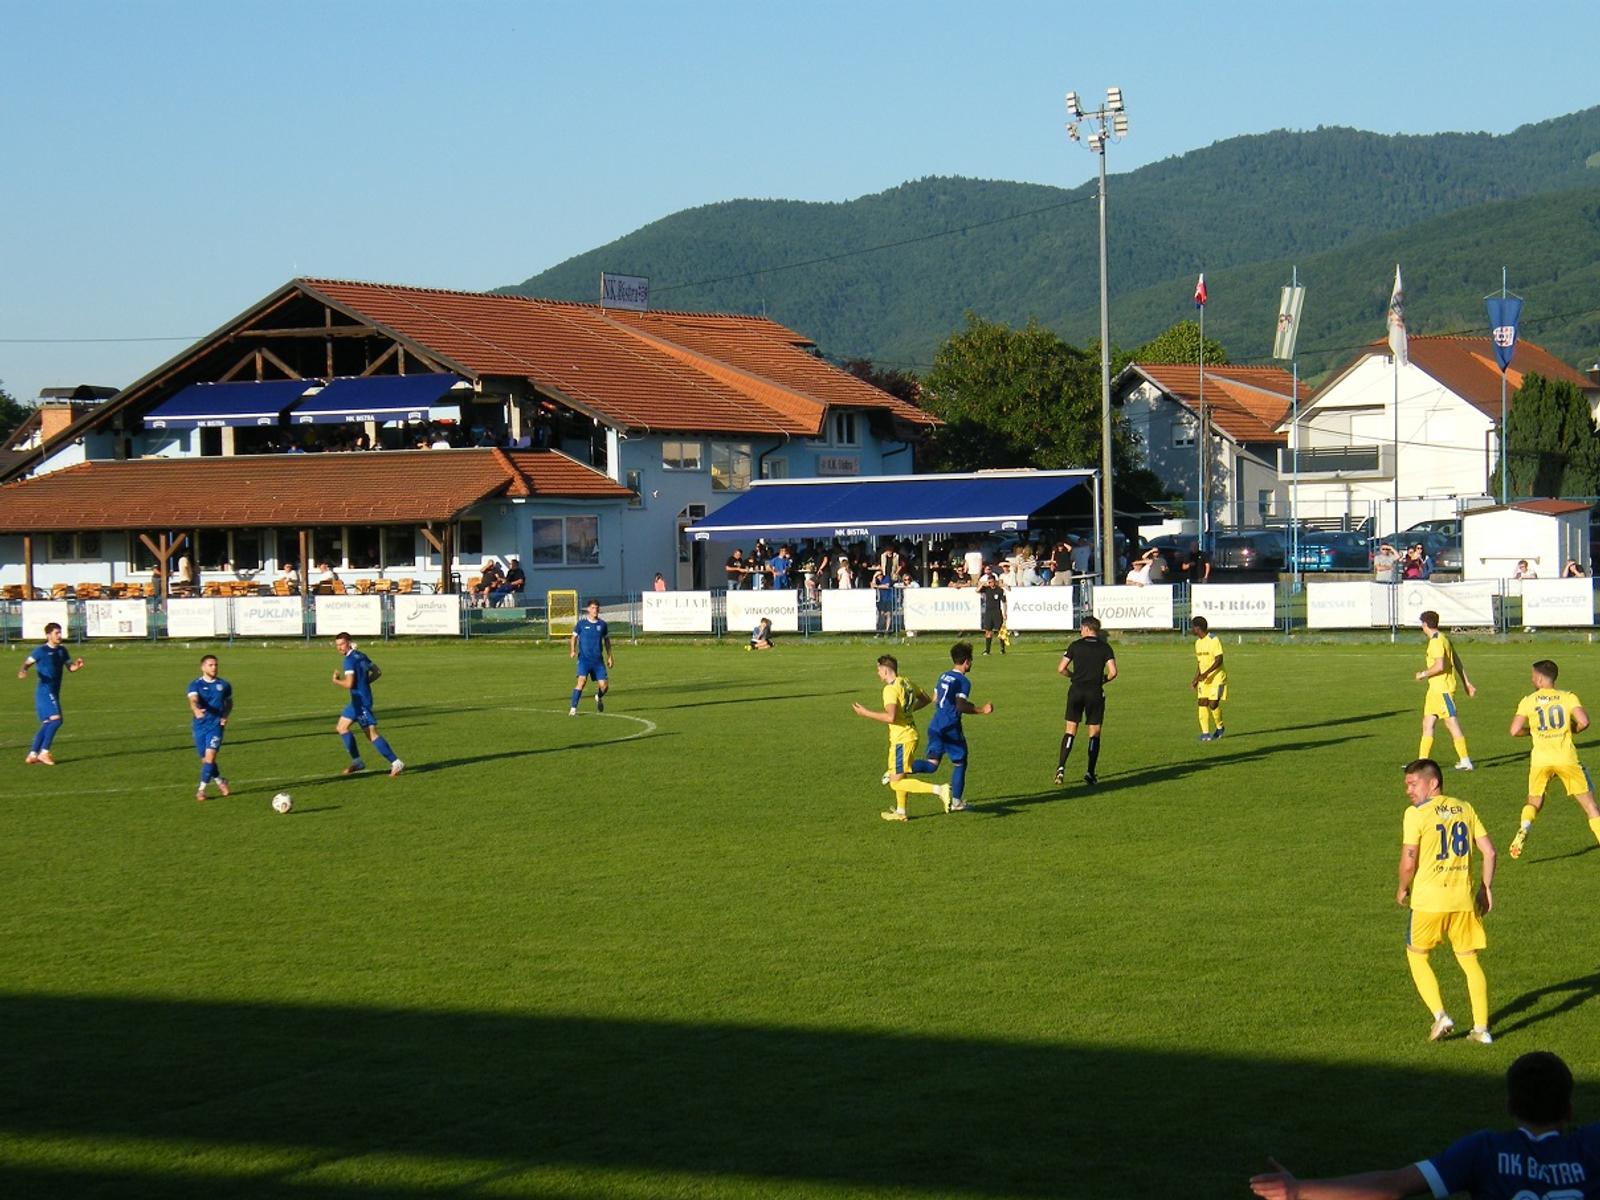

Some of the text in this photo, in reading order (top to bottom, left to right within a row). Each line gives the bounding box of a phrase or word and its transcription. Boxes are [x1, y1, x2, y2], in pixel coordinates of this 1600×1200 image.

[834, 527, 869, 536] NK BISTRA
[744, 606, 795, 616] VINKOPROM
[1012, 601, 1070, 612] Accolade
[1097, 606, 1155, 619] VOĐINAC
[248, 607, 295, 619] PUKLIN
[939, 683, 950, 709] 7
[1535, 704, 1565, 732] 10
[1435, 820, 1470, 861] 18
